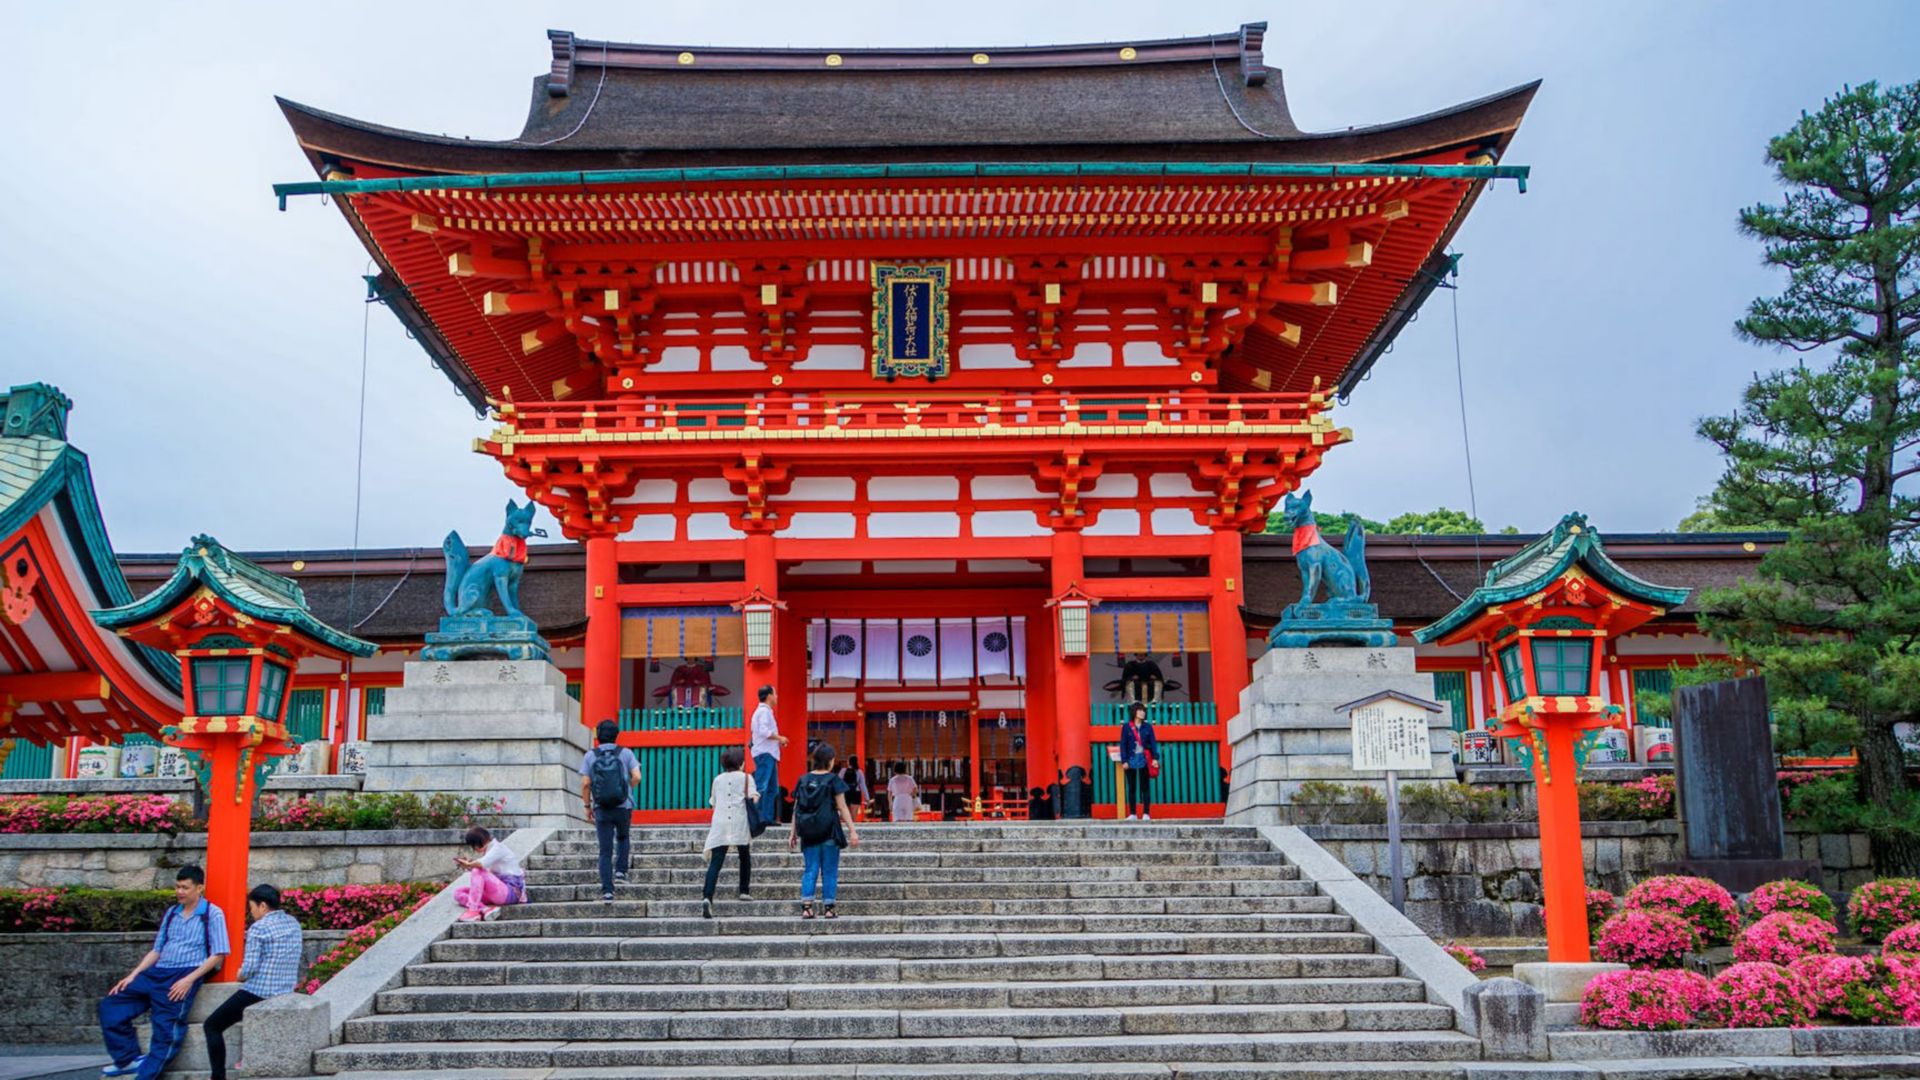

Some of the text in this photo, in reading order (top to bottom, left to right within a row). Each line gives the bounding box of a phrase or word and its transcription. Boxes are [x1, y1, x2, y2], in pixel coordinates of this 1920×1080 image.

[904, 284, 919, 357] 伏見稲荷大社
